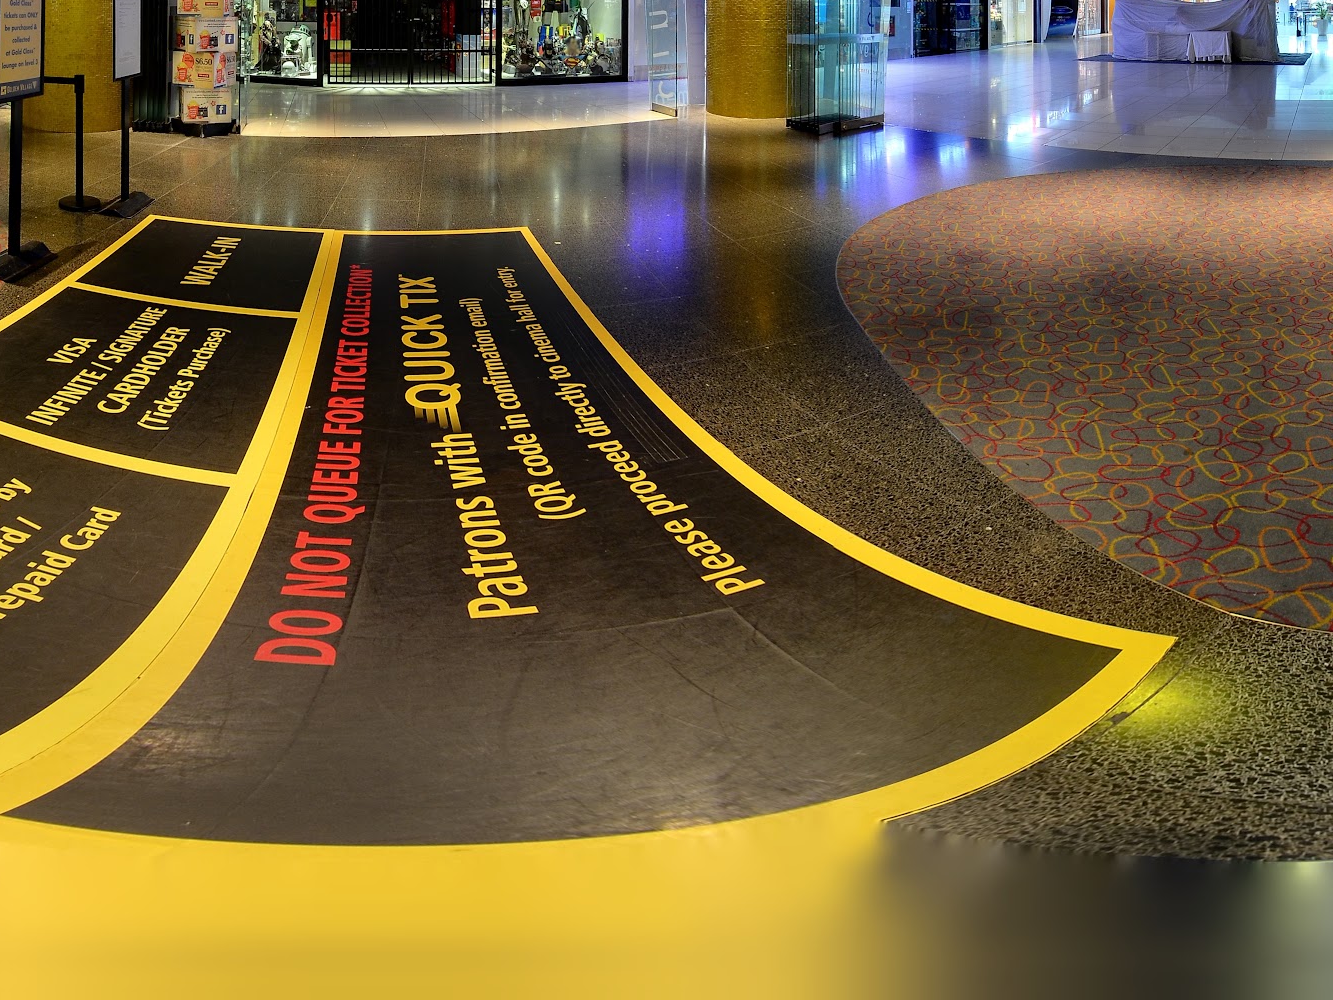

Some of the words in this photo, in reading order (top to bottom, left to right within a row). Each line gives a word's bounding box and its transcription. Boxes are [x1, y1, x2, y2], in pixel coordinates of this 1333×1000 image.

[11, 24, 32, 32] purchased
[12, 48, 22, 56] Gold
[180, 236, 242, 285] WALK-IN
[497, 266, 517, 289] entry.
[459, 297, 488, 330] email)
[506, 286, 525, 304] for
[516, 302, 539, 323] hall
[46, 337, 97, 364] VISA
[98, 307, 167, 363] SIGNATURE
[528, 324, 561, 364] cinema
[91, 361, 113, 371] /
[97, 326, 190, 414] CARDHOLDER
[137, 380, 194, 430] (Tickets
[177, 328, 231, 378] Purchase)
[331, 340, 368, 393] TICKET
[401, 314, 462, 410] QUICK
[473, 330, 521, 410] confirmation
[548, 365, 572, 381] to
[26, 369, 107, 426] INFINITE
[323, 397, 364, 435] FOR
[555, 382, 611, 437] directly
[500, 413, 526, 430] in
[431, 432, 486, 489] with
[507, 433, 553, 477] code
[588, 440, 689, 516] proceed
[303, 441, 366, 524] QUEUE
[528, 480, 587, 520] (QR
[17, 516, 42, 530] /
[60, 506, 122, 551] Card
[281, 531, 353, 598] NOT
[456, 496, 539, 619] Patrons
[664, 518, 765, 595] Please
[254, 610, 343, 666] DO
